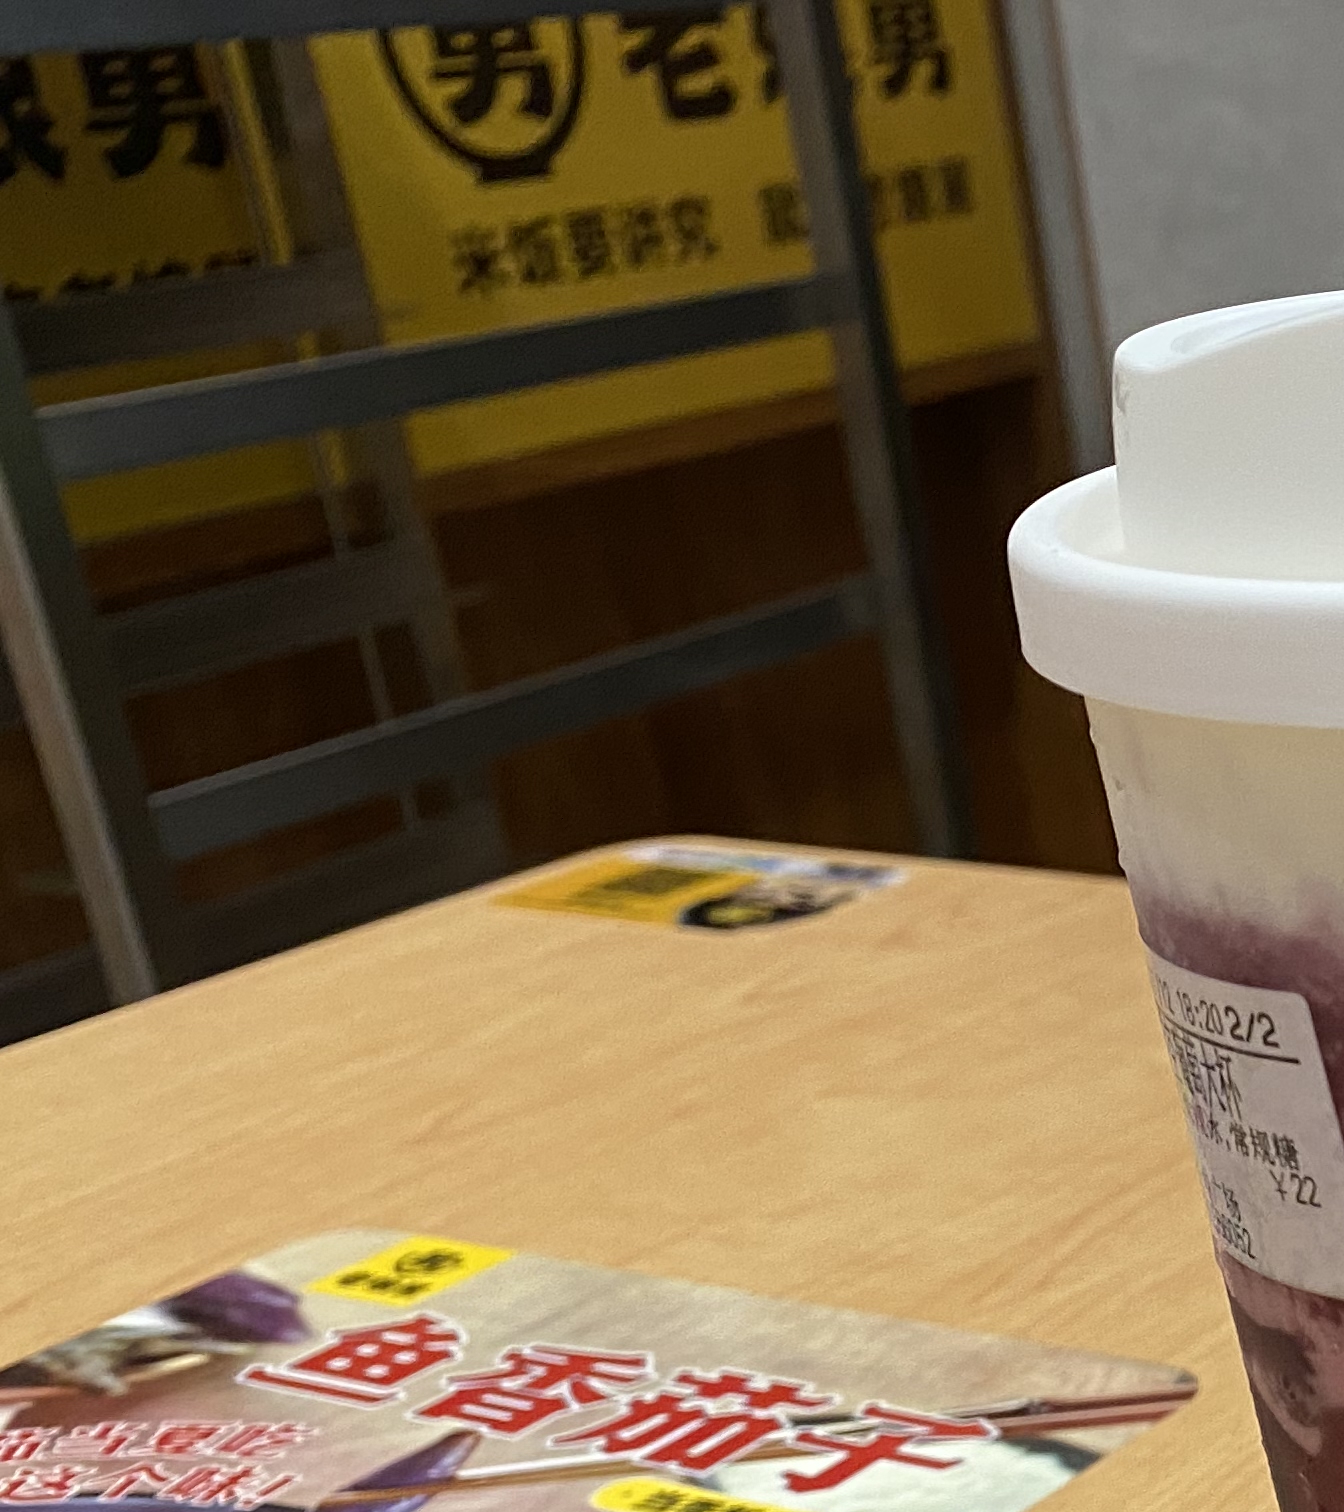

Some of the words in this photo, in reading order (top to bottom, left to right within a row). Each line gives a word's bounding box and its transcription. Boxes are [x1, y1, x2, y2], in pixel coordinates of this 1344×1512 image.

[1224, 1004, 1280, 1048] 2/2
[240, 1313, 996, 1493] 鱼香茄子
